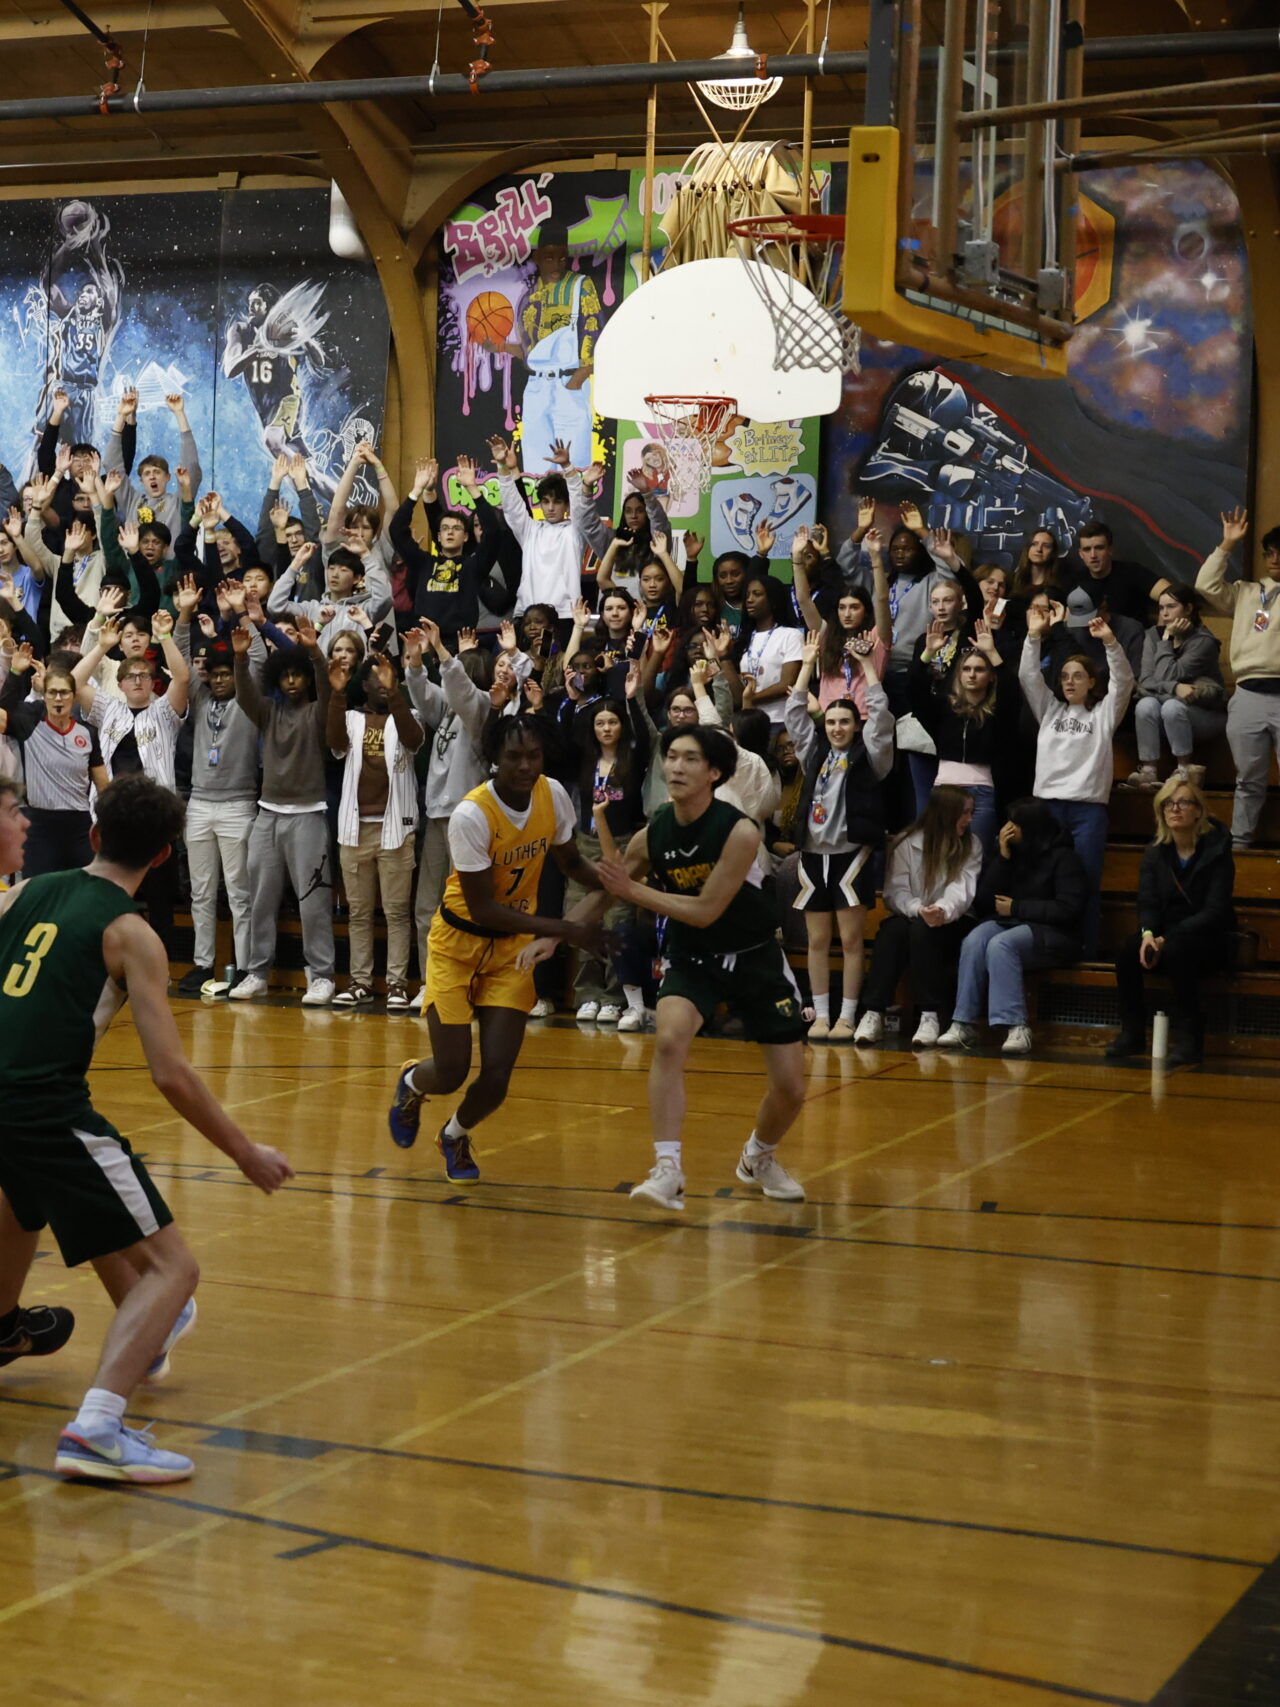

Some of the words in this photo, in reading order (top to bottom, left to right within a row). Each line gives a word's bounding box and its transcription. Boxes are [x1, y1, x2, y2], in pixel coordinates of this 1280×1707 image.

[75, 333, 94, 350] 35
[251, 360, 273, 384] 16
[491, 838, 548, 866] LUTHER
[504, 866, 526, 897] 7
[2, 922, 59, 998] 3
